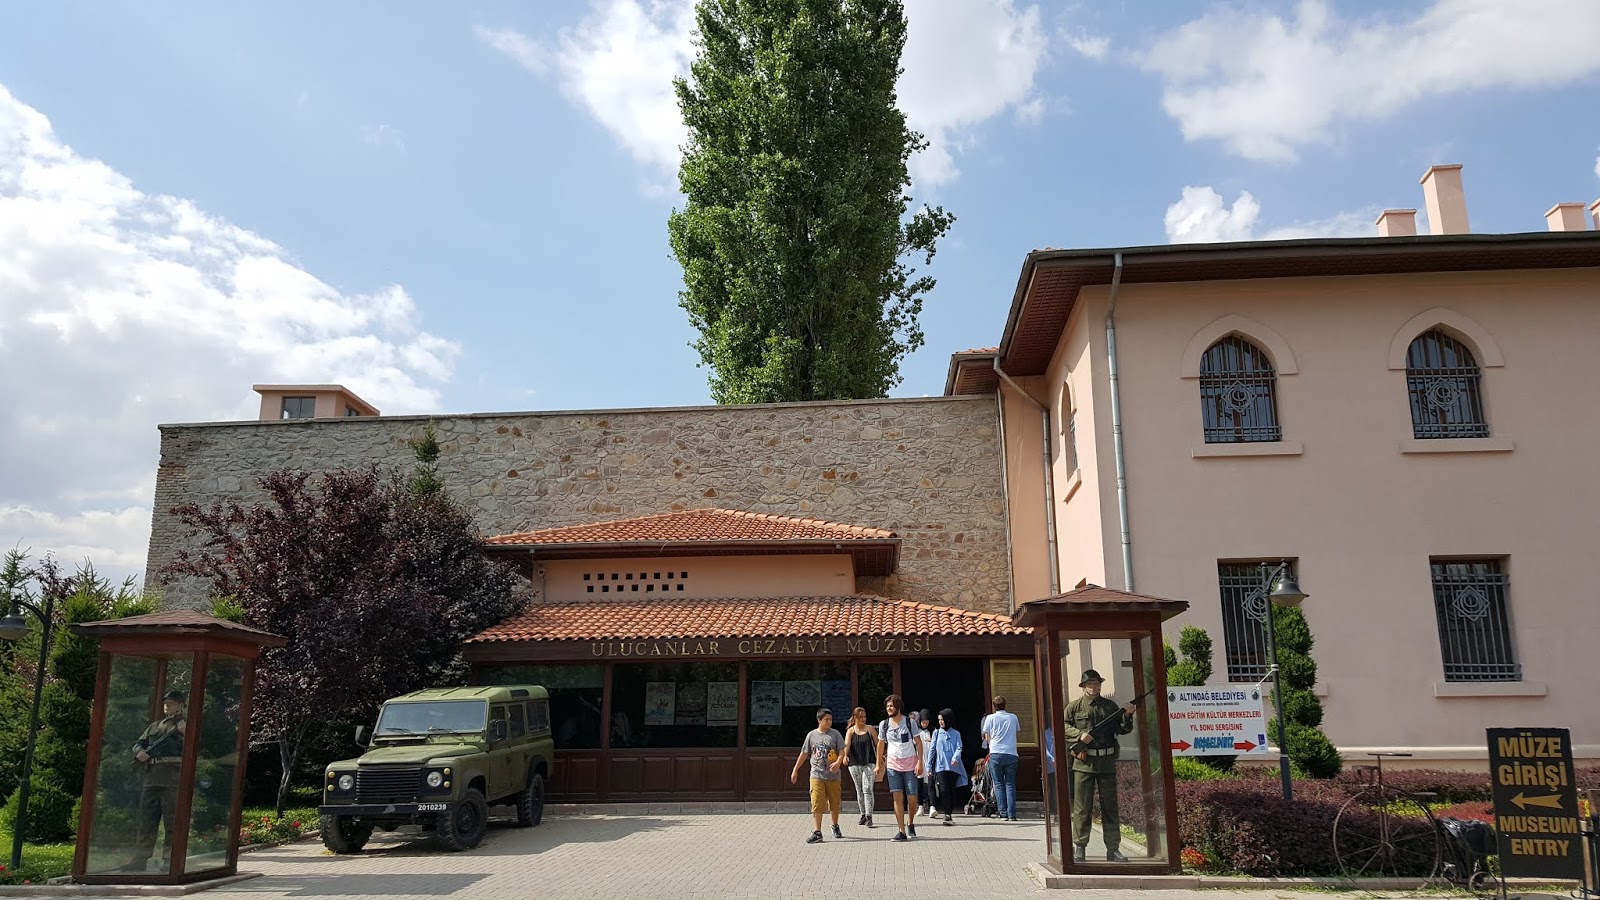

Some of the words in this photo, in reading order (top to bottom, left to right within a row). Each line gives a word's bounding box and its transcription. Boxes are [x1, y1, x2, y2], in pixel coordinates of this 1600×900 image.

[592, 641, 720, 656] ULUCANLAR
[738, 638, 829, 653] CEZAEVİ
[847, 636, 931, 652] MÜZESİ
[1179, 691, 1209, 701] ALTINDAĞ
[1211, 690, 1247, 701] BELEDİYESİ
[1206, 711, 1228, 719] KÜLTÜR
[1228, 710, 1261, 718] MERKEZLERİ
[1215, 722, 1243, 730] SERGİSİNE
[1498, 732, 1562, 758] MÜZE
[1499, 762, 1568, 792] GİRİŞİ
[1500, 816, 1578, 834] MUSEUM
[1512, 839, 1569, 855] ENTRY
